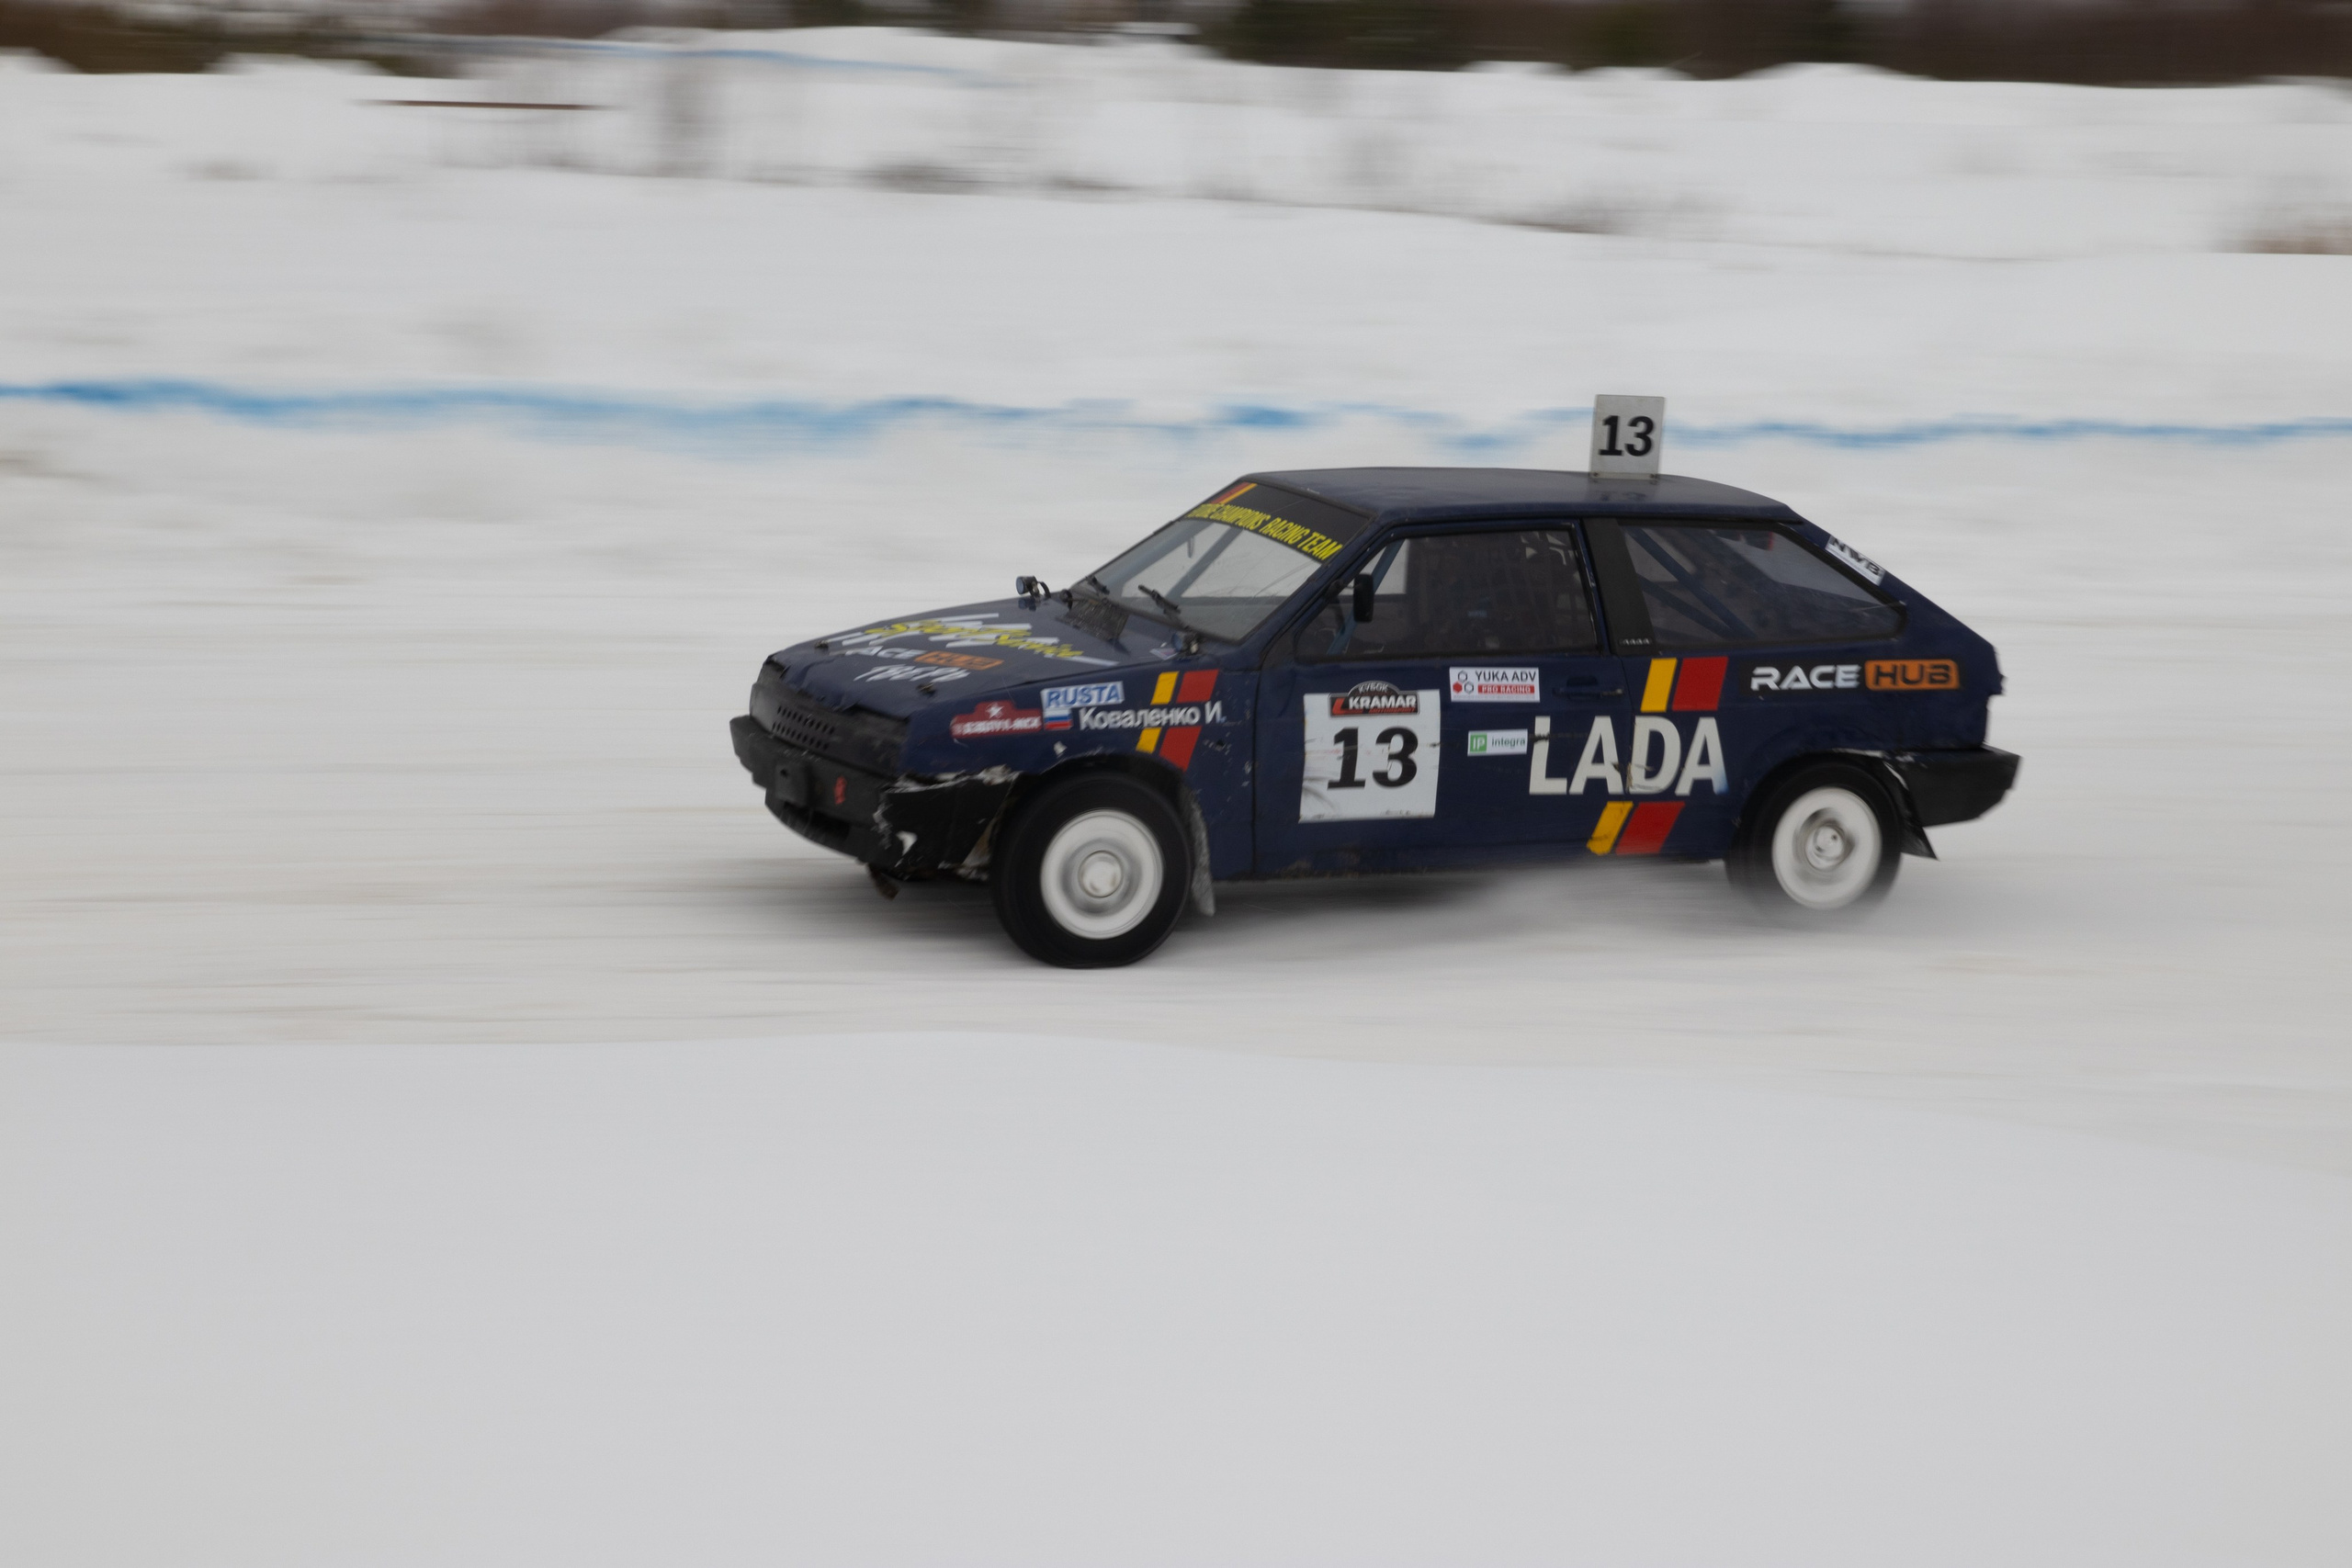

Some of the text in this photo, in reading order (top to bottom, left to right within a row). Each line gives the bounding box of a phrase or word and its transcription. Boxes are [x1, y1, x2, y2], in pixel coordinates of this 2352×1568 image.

[1599, 414, 1655, 457] 13
[1259, 517, 1310, 545] RACING
[1297, 531, 1343, 560] TEAM
[1475, 670, 1536, 682] YUKA ADV
[1750, 663, 1951, 691] RACE HUB
[1046, 684, 1121, 706] RUSTA
[1481, 684, 1531, 694] PRO RACING
[1348, 694, 1417, 710] KRAMAR
[1079, 706, 1201, 730] Коваленко
[1473, 737, 1525, 750] IP integra
[1529, 716, 1729, 795] LADA
[1327, 727, 1419, 790] 13
